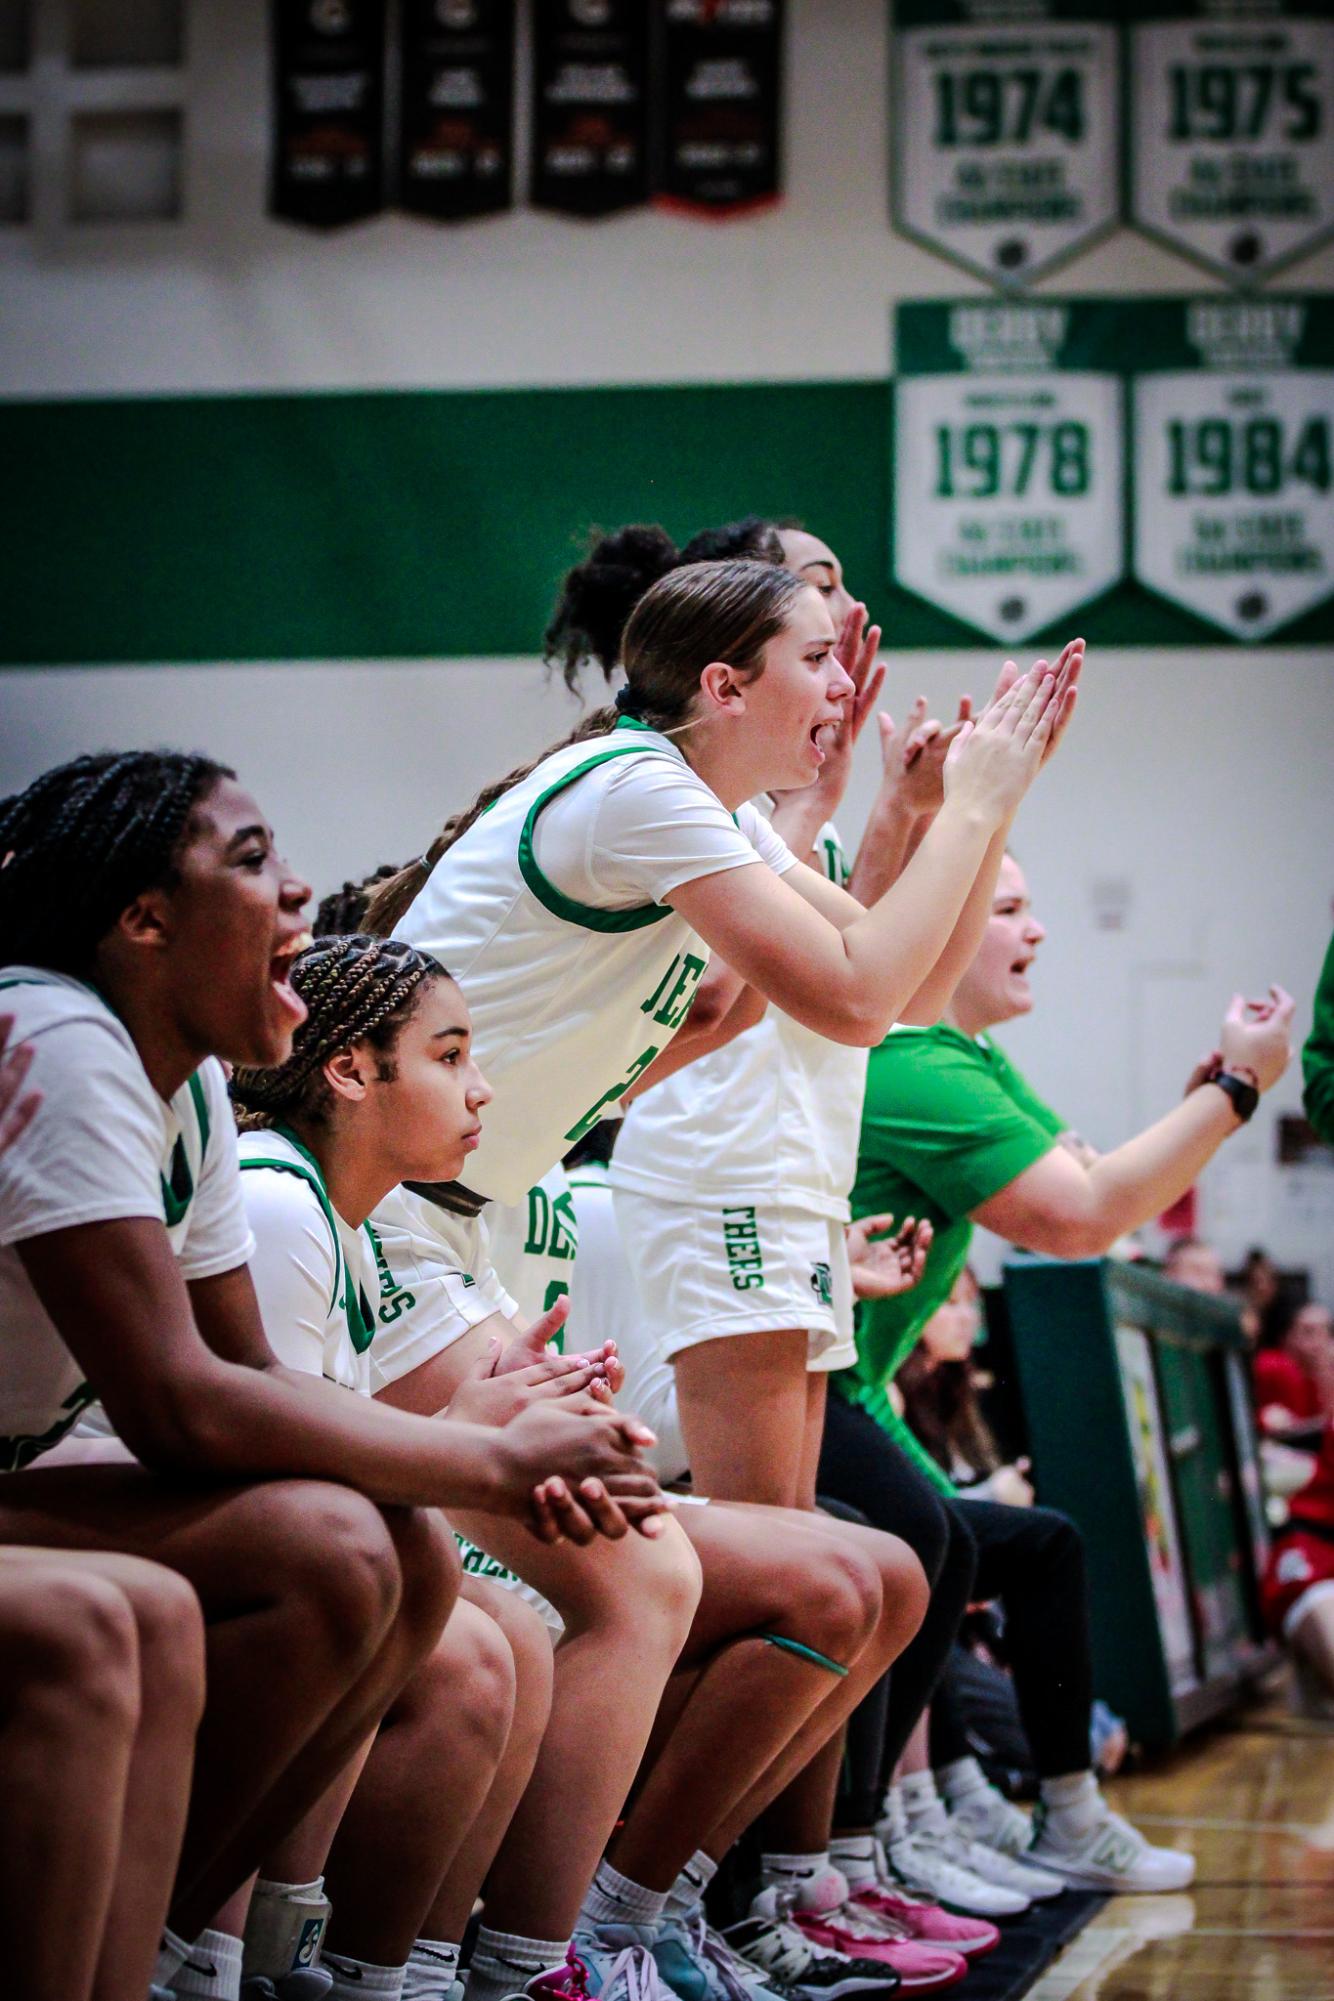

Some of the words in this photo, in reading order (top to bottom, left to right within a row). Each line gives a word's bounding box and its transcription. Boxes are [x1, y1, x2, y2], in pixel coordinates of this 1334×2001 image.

[937, 69, 1084, 146] 1974
[1169, 64, 1323, 141] 1975
[935, 420, 1091, 497] 1978
[1167, 416, 1333, 495] 1984
